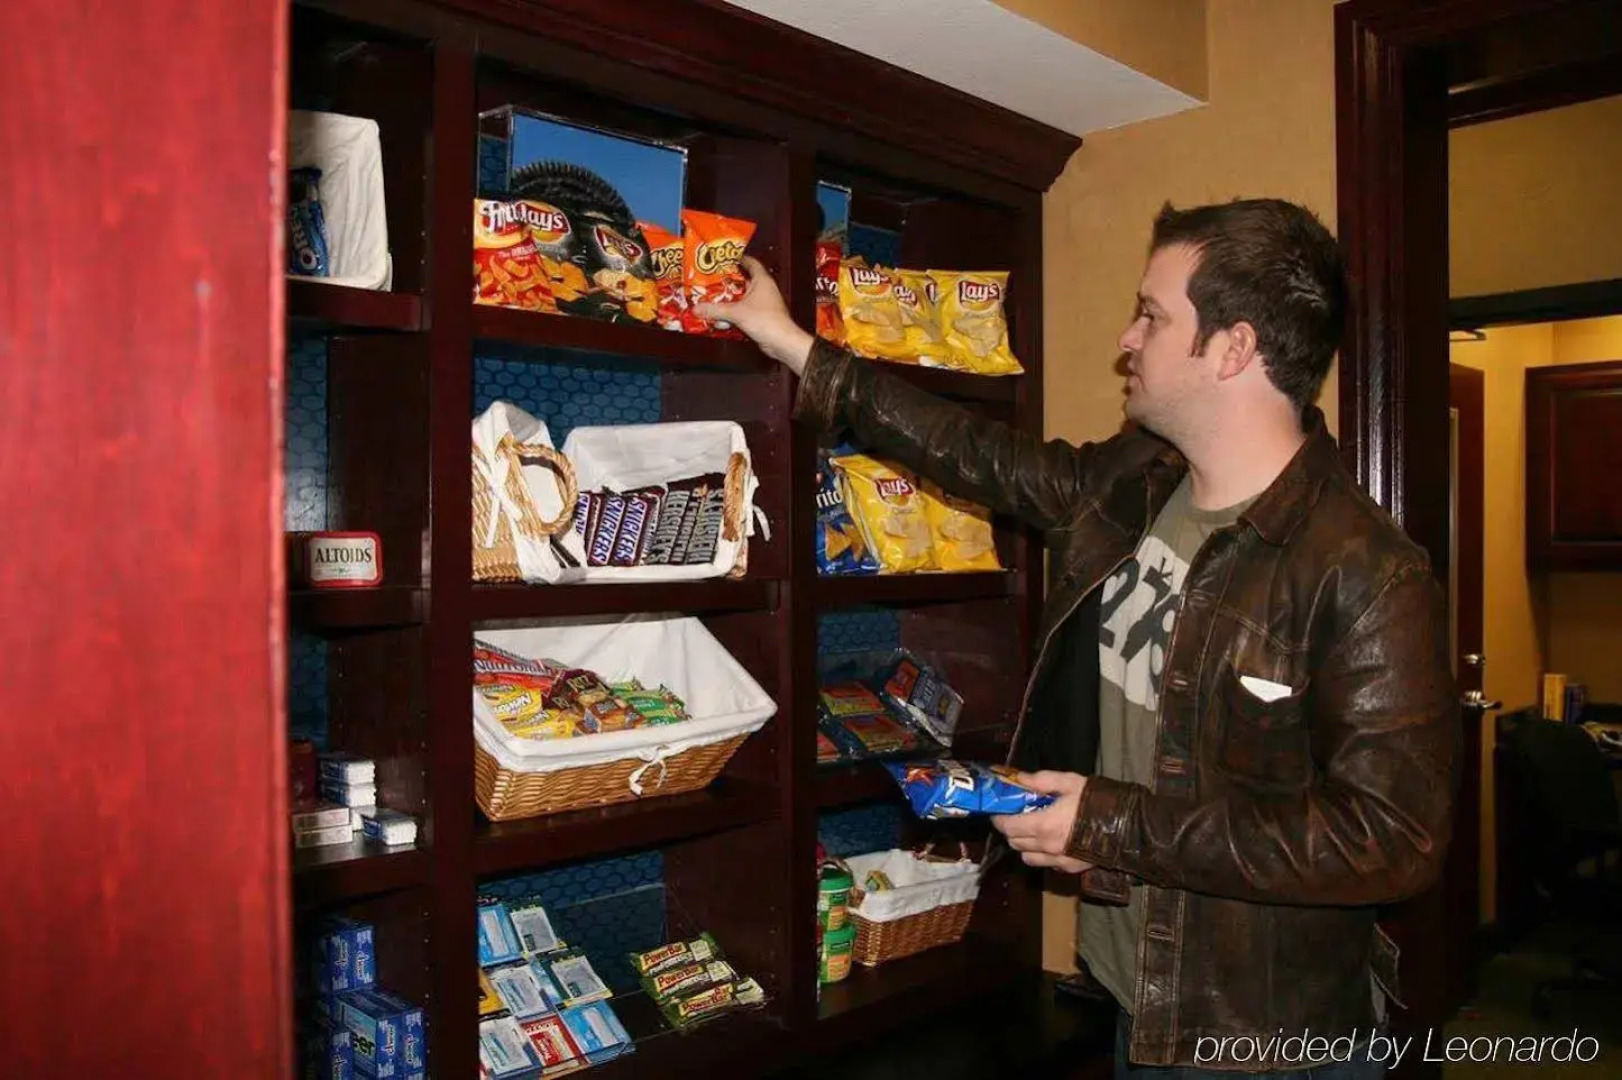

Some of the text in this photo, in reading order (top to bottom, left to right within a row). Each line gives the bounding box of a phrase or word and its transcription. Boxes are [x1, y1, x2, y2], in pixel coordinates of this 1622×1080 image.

[651, 248, 683, 276] Chee
[593, 495, 626, 564] SNICKERS
[614, 497, 648, 563] SNICKERS
[315, 548, 372, 563] ALTOIDS
[643, 943, 682, 966] PowerBar
[659, 965, 699, 988] PowerBar
